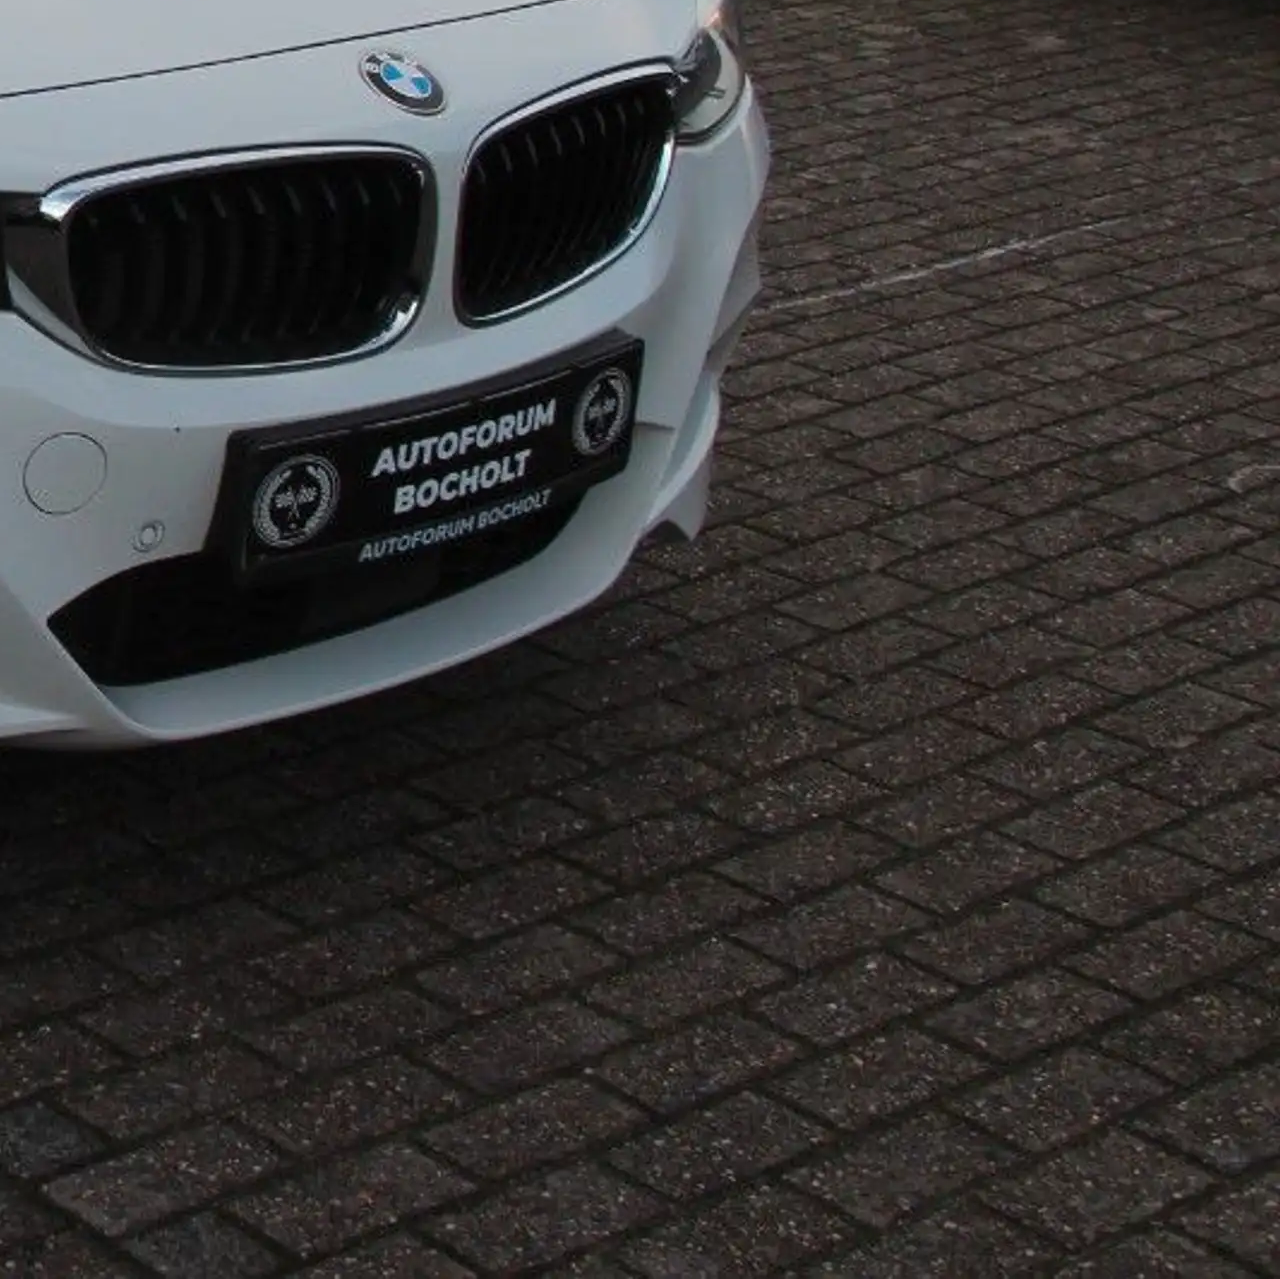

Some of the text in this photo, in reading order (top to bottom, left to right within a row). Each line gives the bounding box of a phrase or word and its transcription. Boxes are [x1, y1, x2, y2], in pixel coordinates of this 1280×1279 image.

[371, 399, 556, 476] AUTOFORUM
[394, 449, 532, 514] BOCHOLT
[358, 488, 552, 562] AUTOFORUM BOCHOLT
